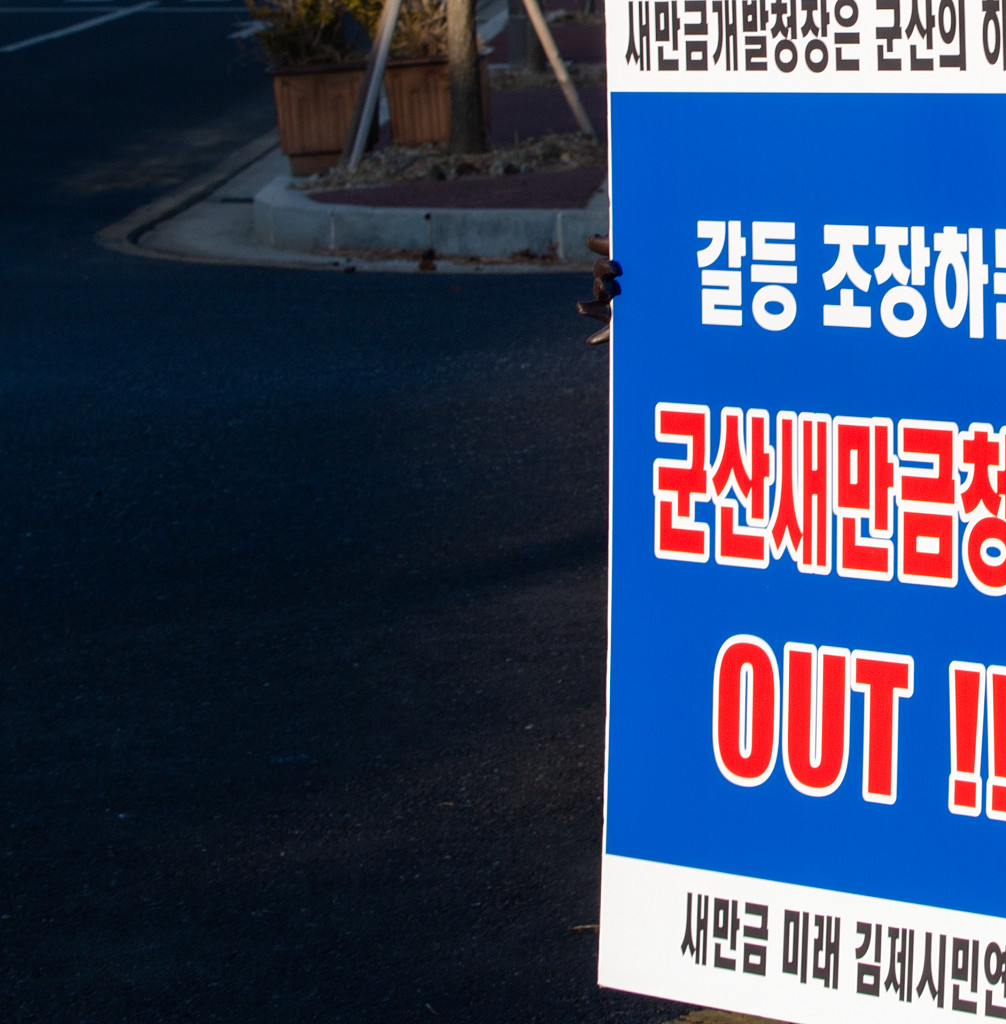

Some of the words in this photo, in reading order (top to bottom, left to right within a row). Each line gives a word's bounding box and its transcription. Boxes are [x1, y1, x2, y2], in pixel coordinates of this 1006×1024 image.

[696, 220, 798, 331] 갈등
[713, 635, 914, 805] OUT
[681, 891, 770, 977] 새만금
[782, 908, 841, 990] 미래
